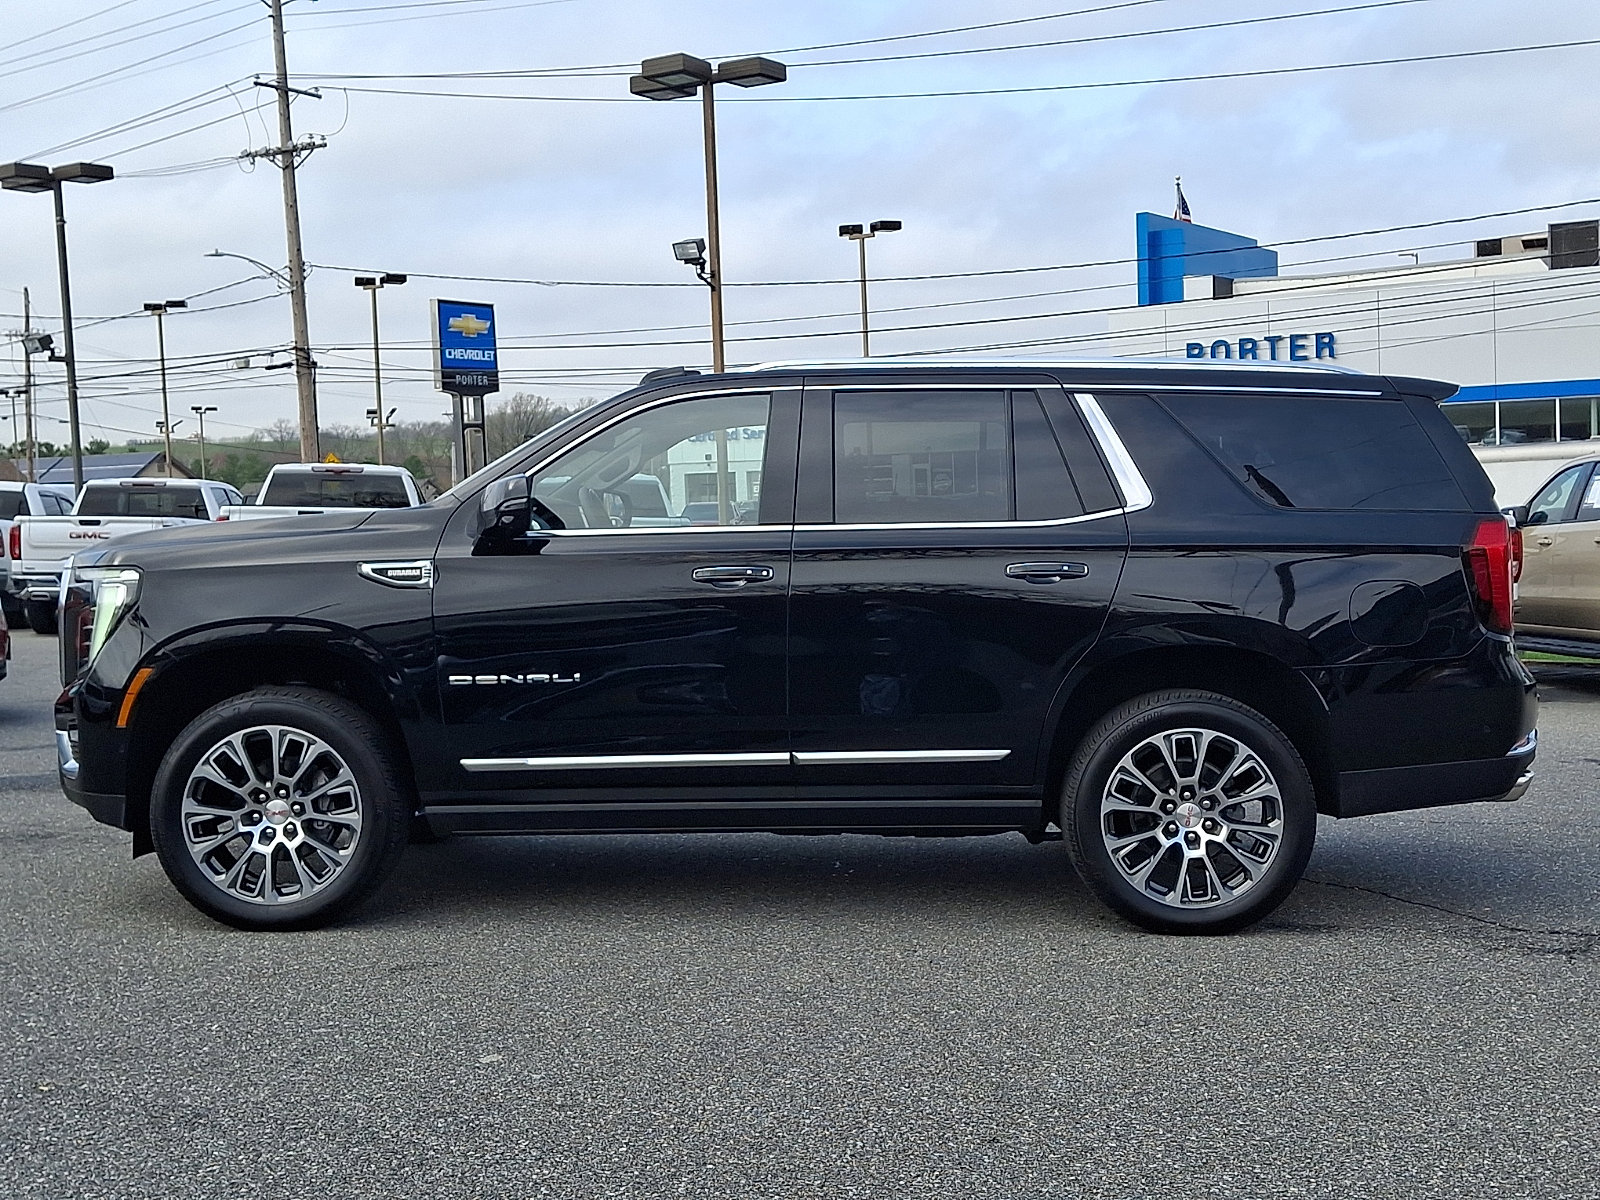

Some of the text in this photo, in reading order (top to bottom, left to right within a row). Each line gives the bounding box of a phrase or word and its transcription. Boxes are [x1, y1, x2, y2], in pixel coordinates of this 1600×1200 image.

[1185, 331, 1335, 362] PORTER
[445, 348, 495, 361] CHEVROLET
[455, 374, 489, 386] PORTER
[69, 531, 111, 540] GMC
[387, 569, 421, 577] DURAMAX
[448, 673, 581, 685] DENALI
